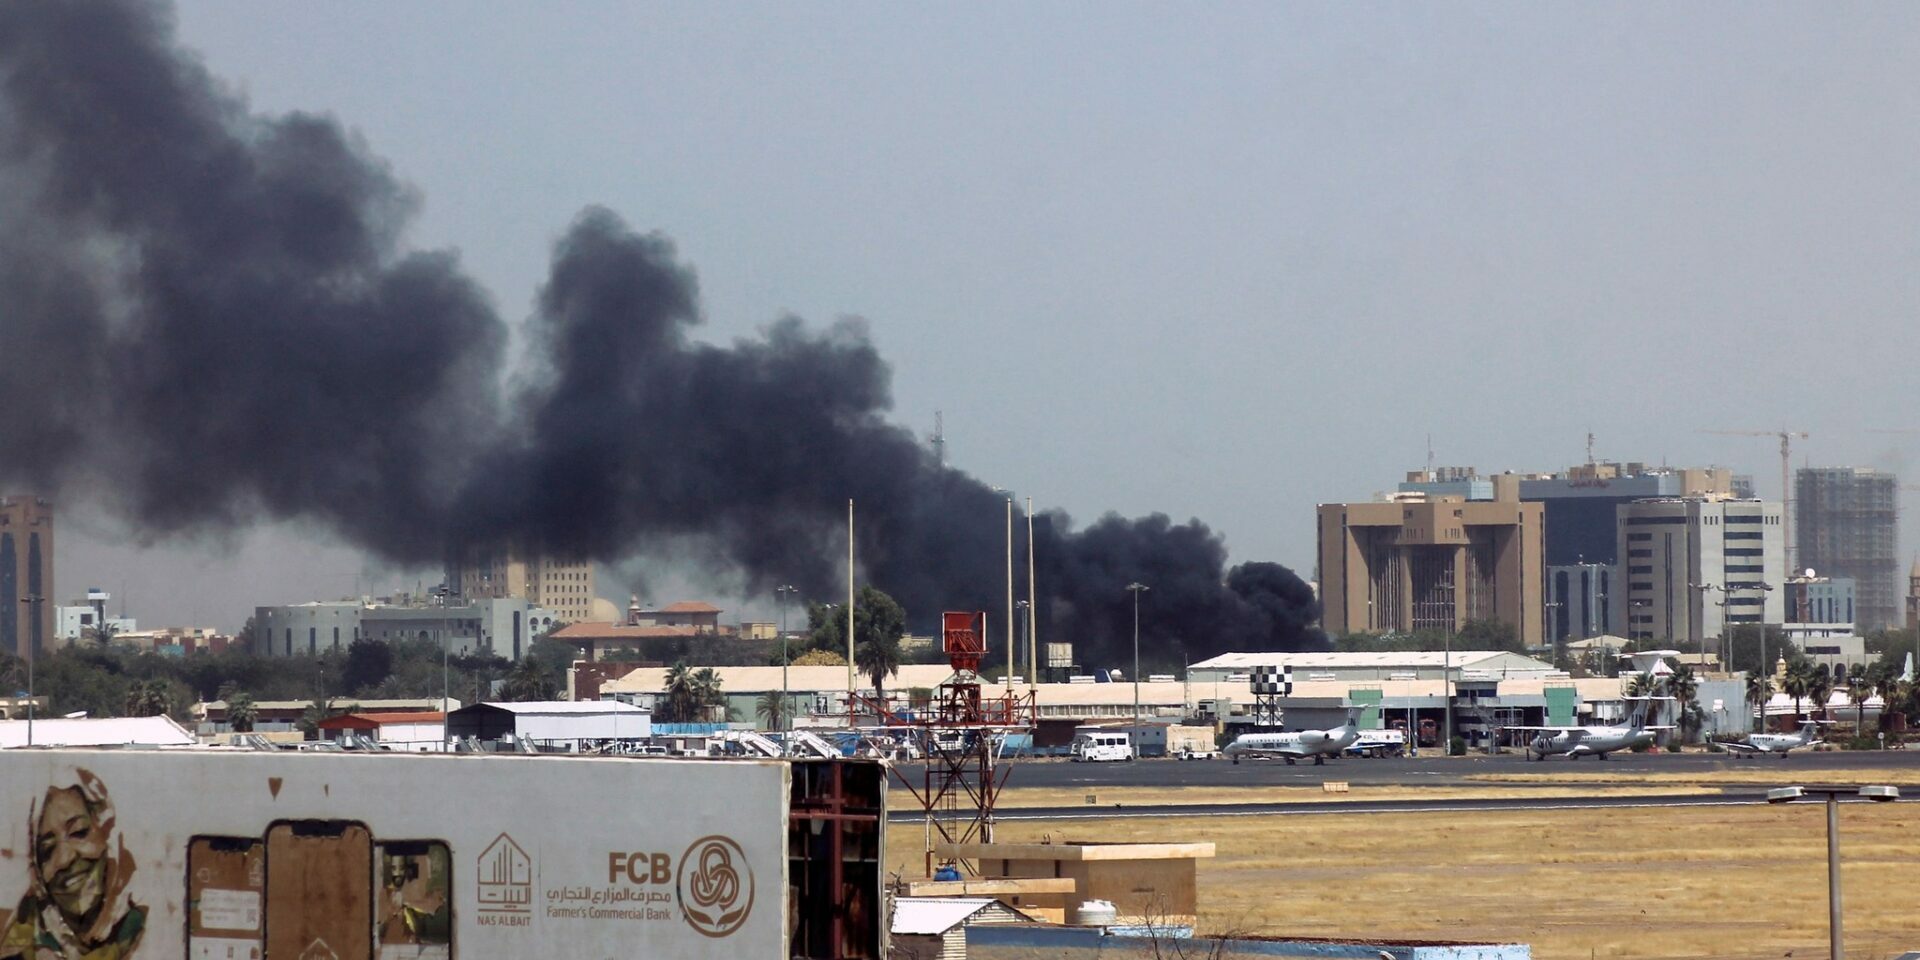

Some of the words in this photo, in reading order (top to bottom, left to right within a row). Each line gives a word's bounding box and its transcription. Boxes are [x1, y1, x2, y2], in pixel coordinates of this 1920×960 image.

[608, 852, 672, 885] FCB
[546, 886, 591, 904] التجاري
[591, 887, 630, 905] المزارع
[630, 888, 671, 905] مصرف
[477, 915, 497, 926] NAS
[498, 915, 531, 927] ALBAIT
[546, 906, 587, 920] Farmer's
[588, 906, 644, 921] Commercial
[646, 907, 671, 921] Bank
